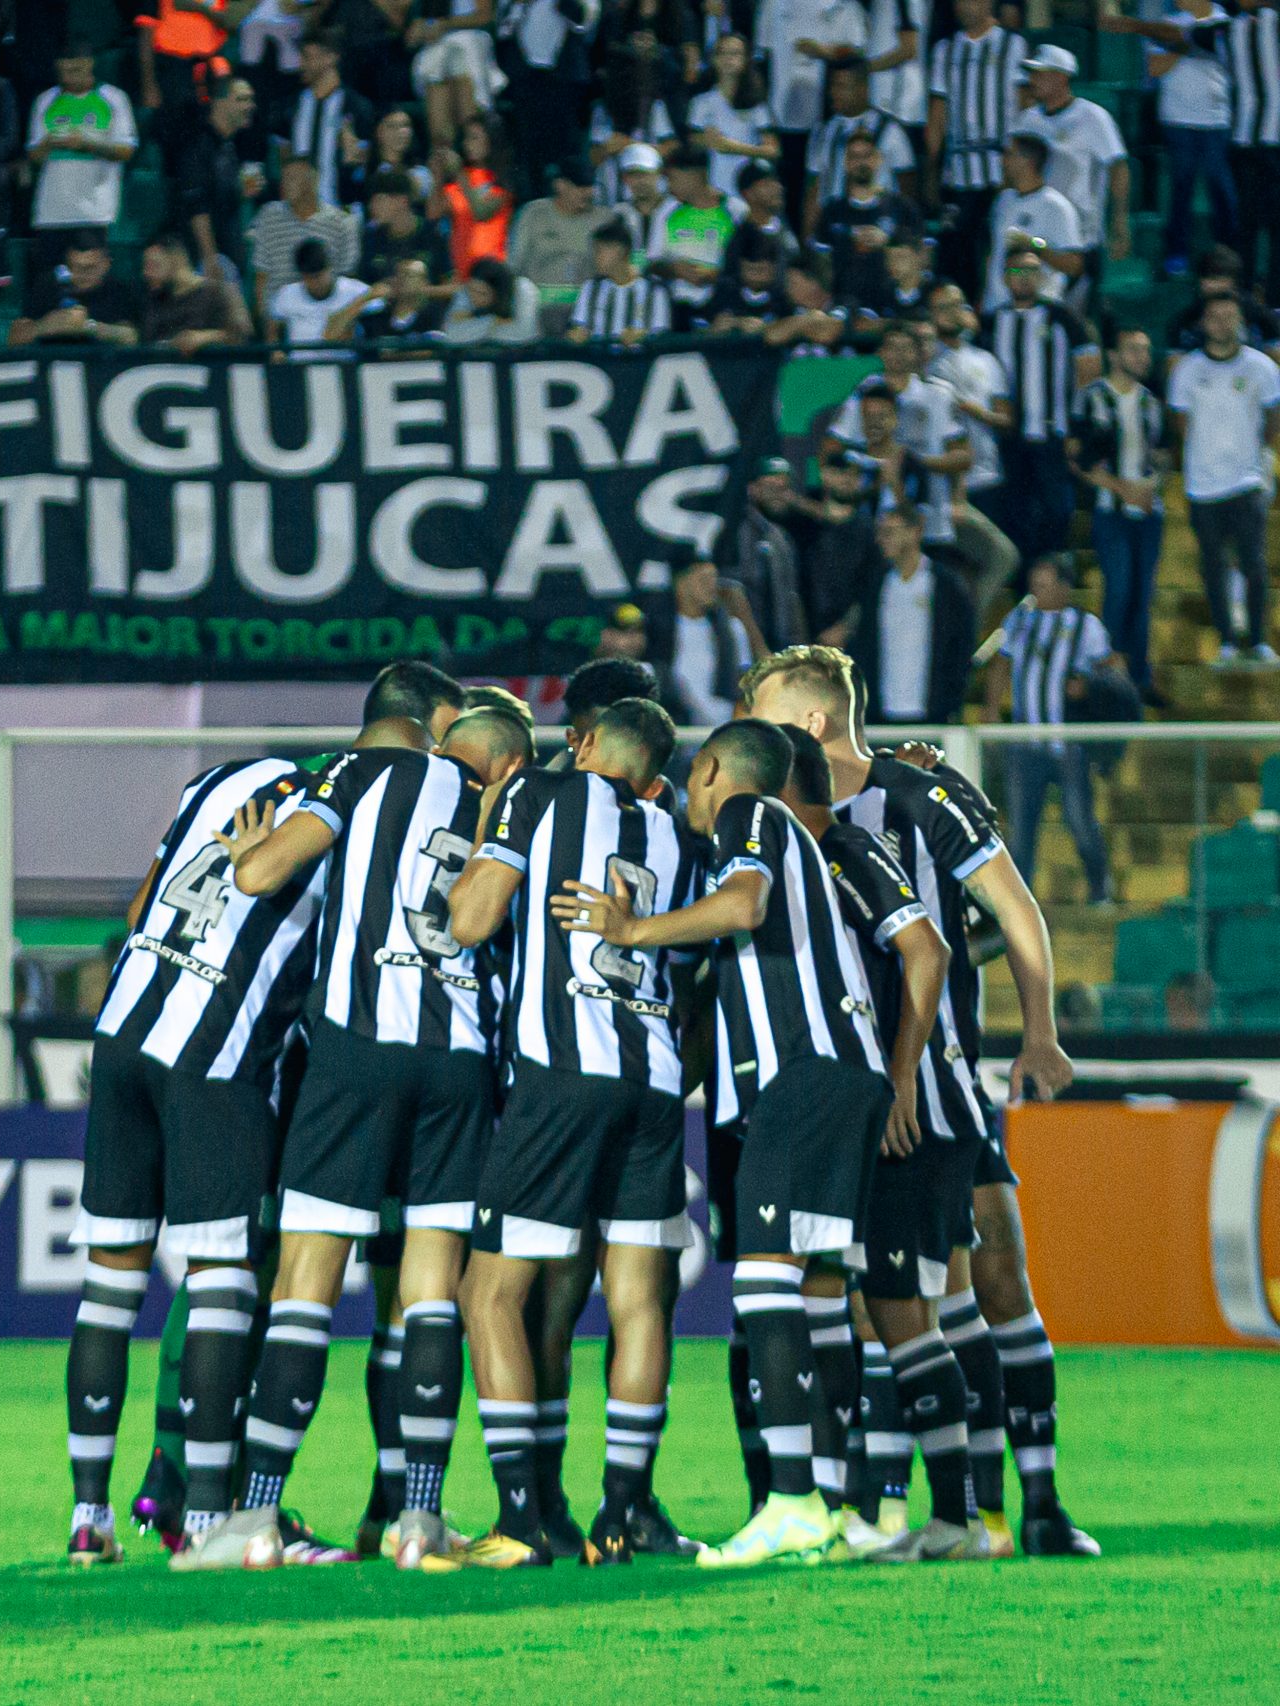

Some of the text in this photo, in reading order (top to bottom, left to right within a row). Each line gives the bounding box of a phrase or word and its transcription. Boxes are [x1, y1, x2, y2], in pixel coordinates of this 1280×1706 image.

[21, 610, 201, 658] MAIOR
[206, 613, 442, 662] TORCIDA
[159, 840, 232, 943] 4
[589, 853, 658, 988] 2
